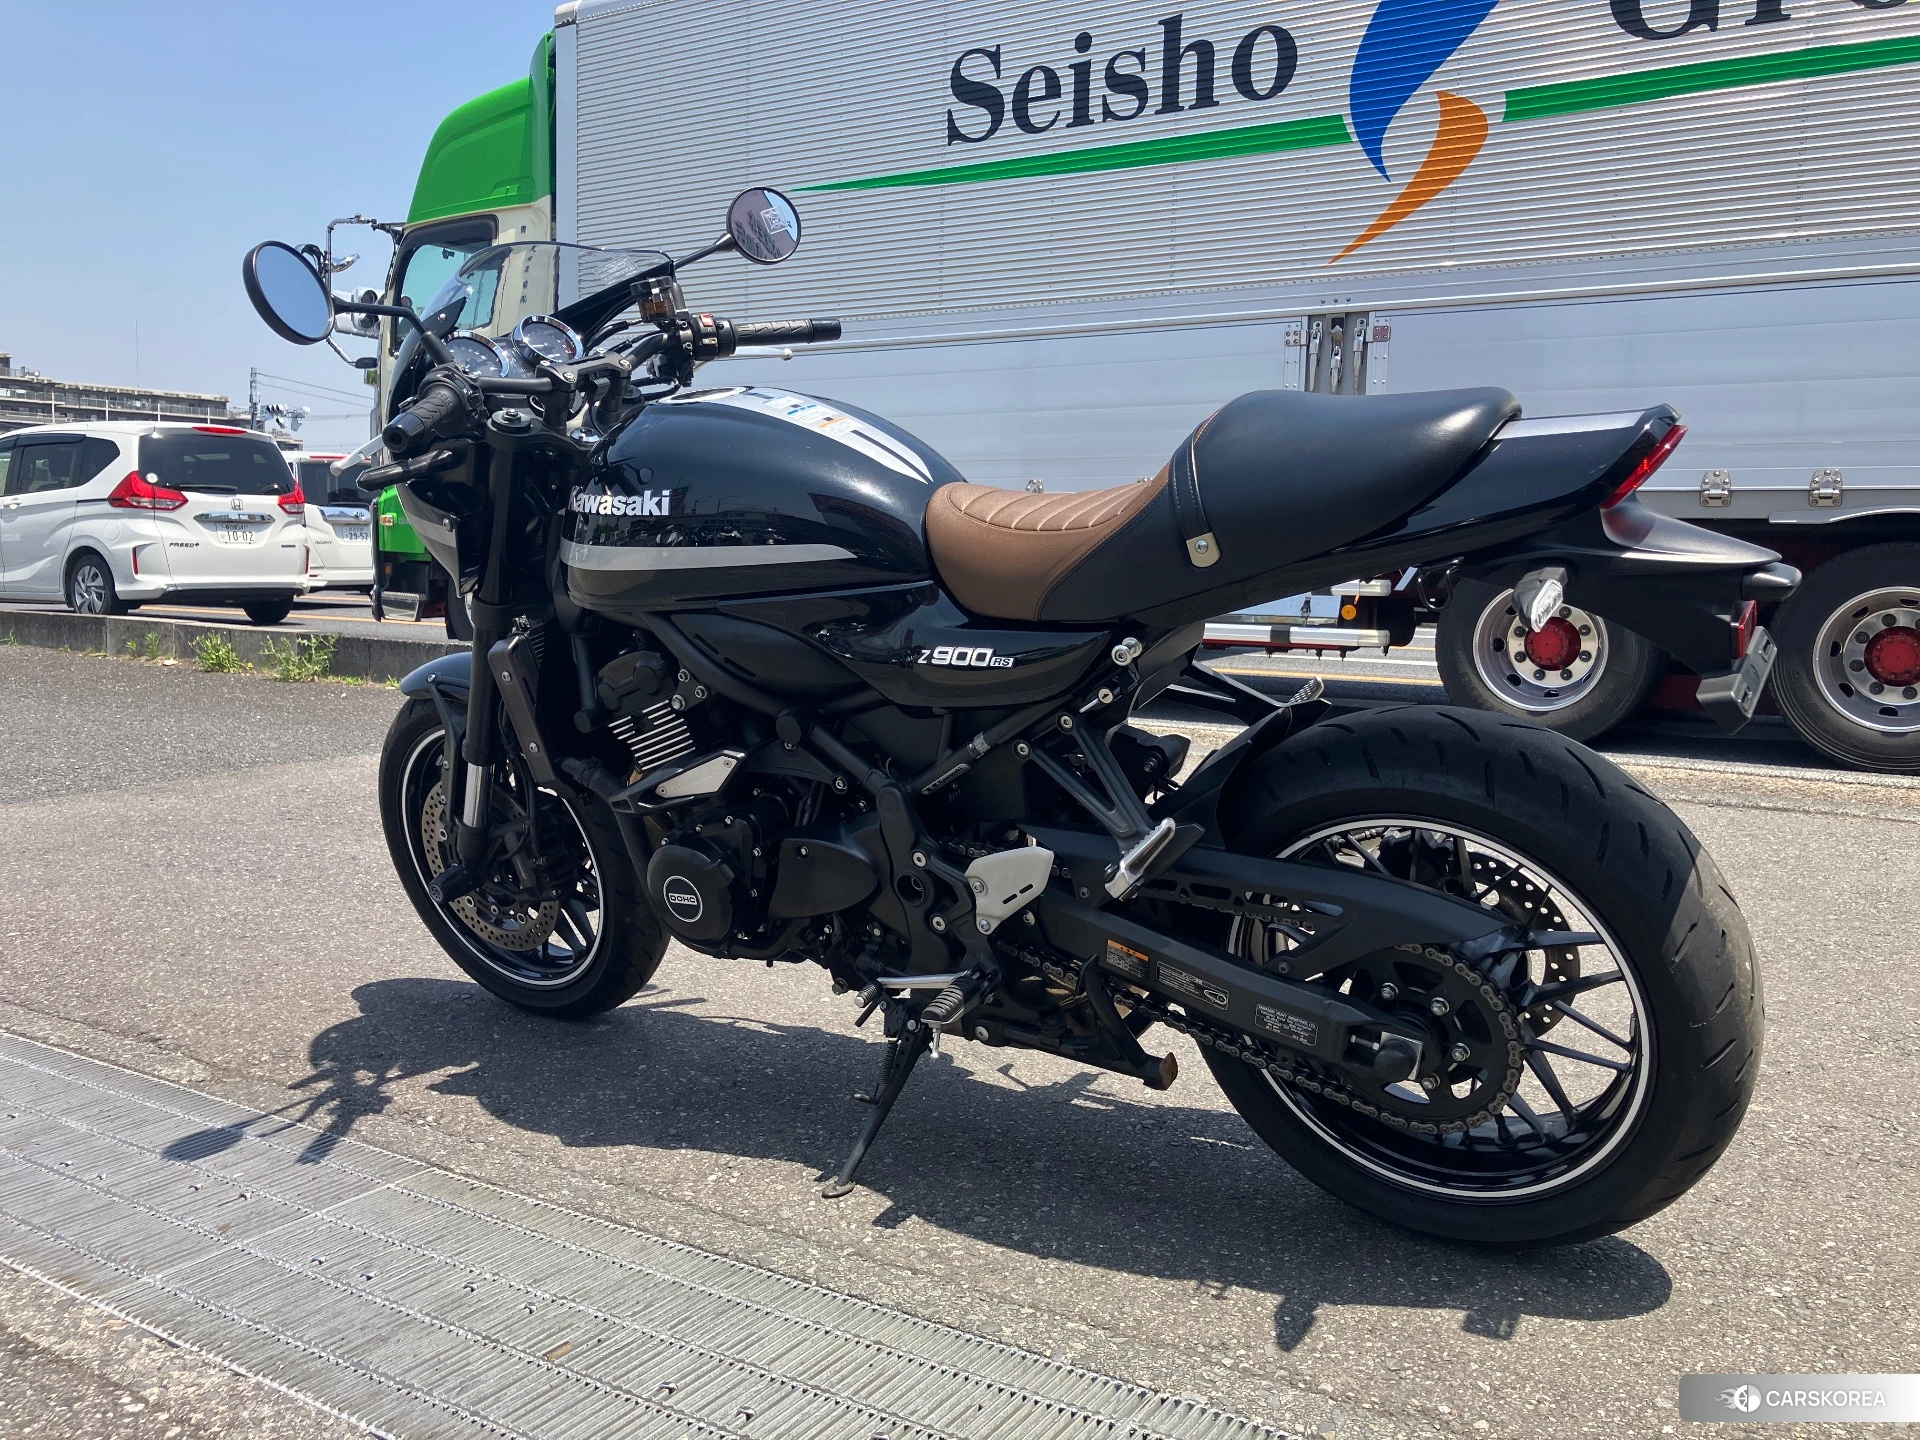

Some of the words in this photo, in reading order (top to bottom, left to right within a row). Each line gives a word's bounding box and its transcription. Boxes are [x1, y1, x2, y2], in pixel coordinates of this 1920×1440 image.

[947, 13, 1298, 146] Seisho
[568, 486, 671, 516] Kawasaki
[227, 531, 254, 541] 10-02
[670, 894, 696, 903] DOHC
